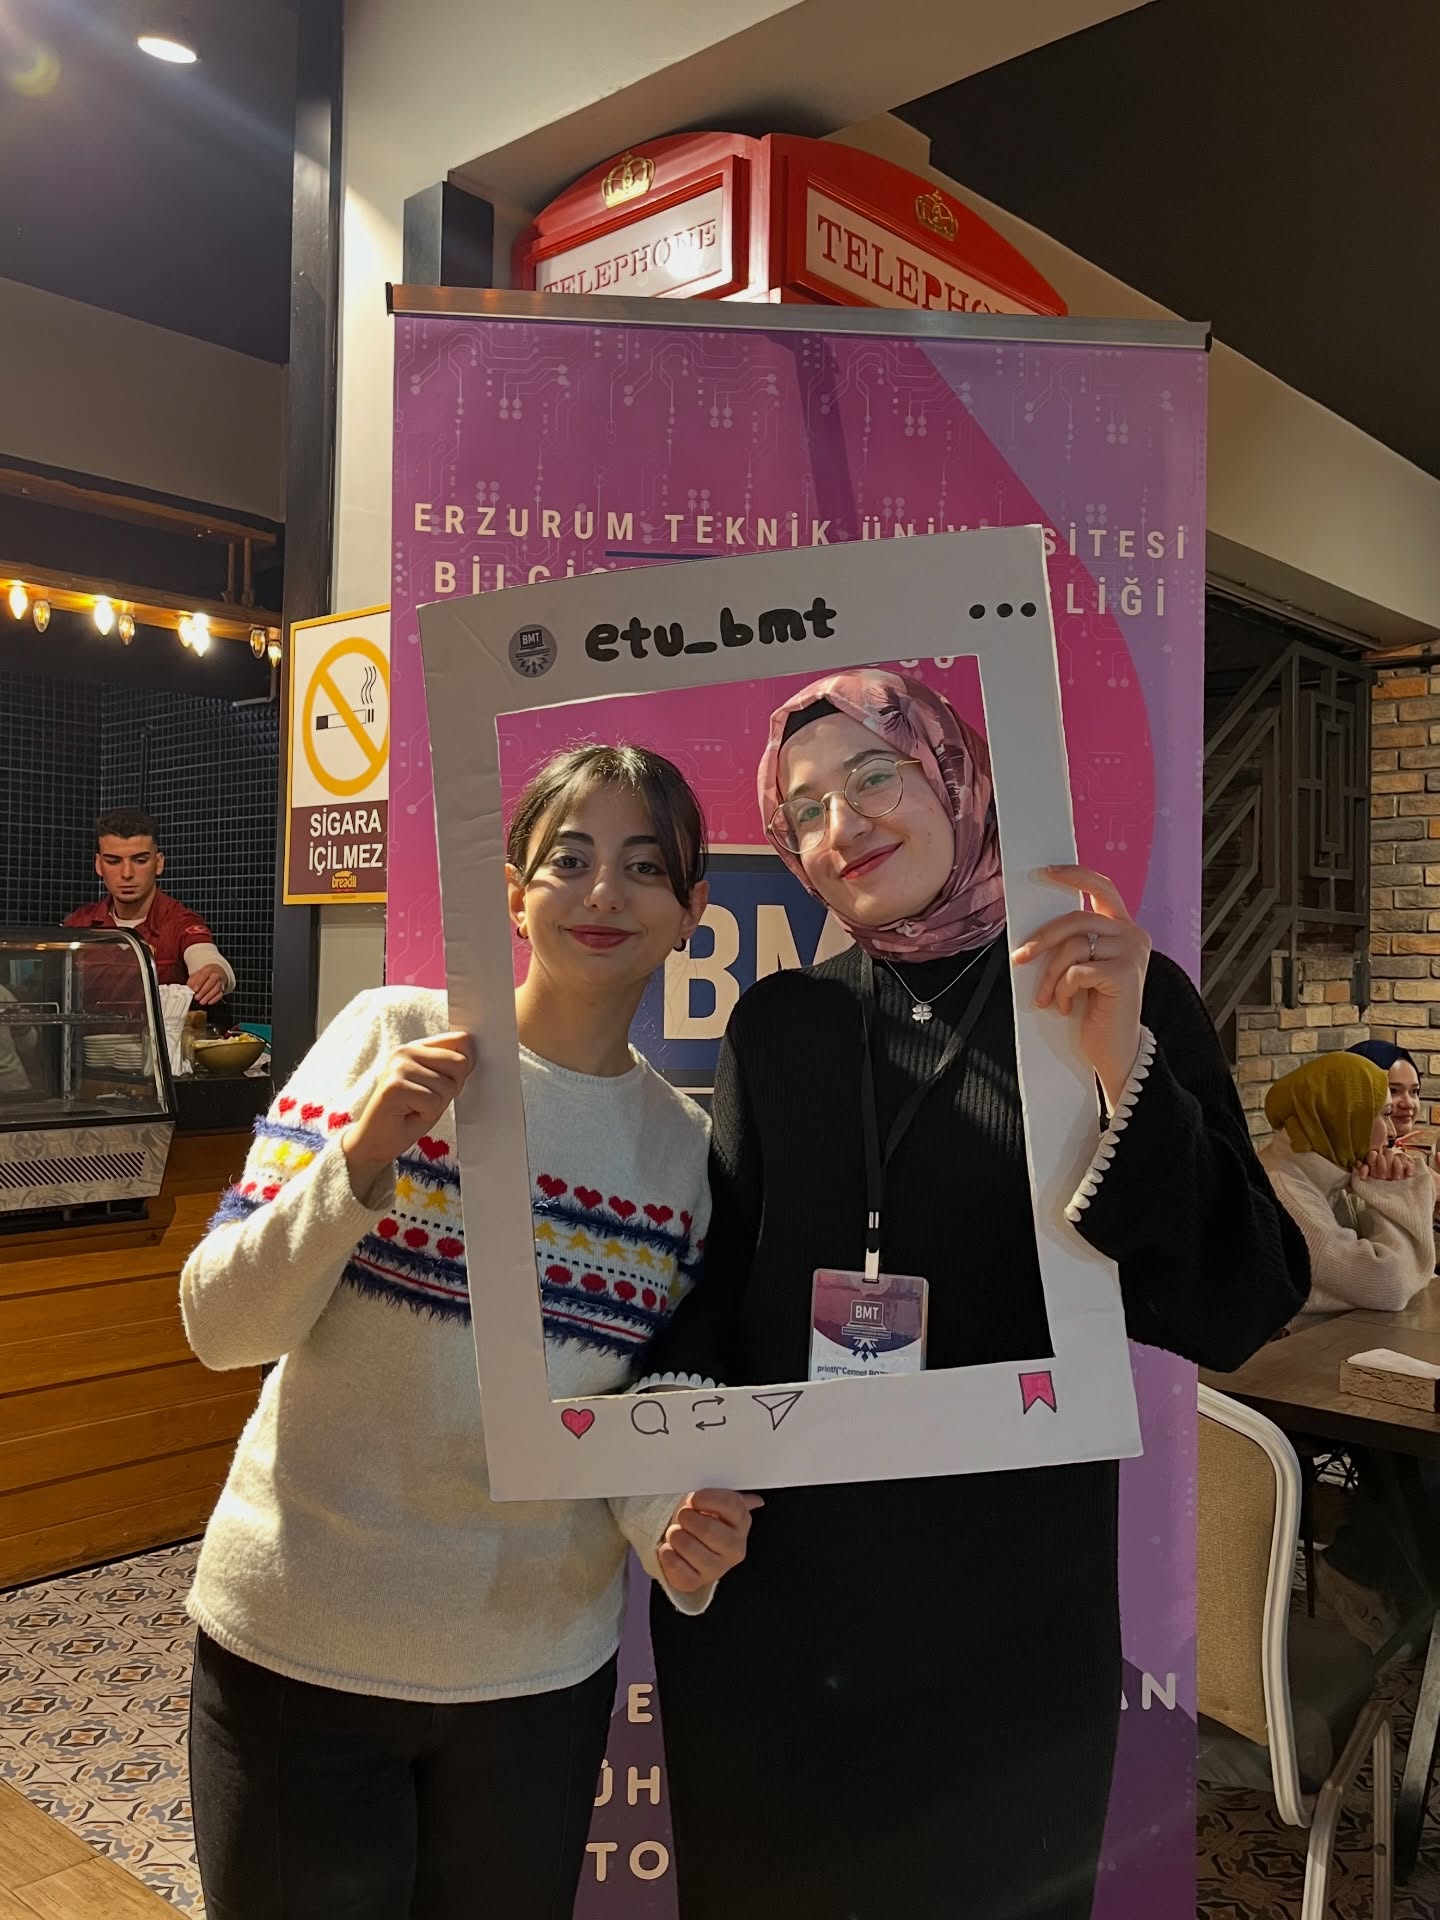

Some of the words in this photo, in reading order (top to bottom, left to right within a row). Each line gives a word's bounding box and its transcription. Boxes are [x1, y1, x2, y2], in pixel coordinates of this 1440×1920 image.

[818, 214, 1003, 313] TELEPH
[414, 503, 634, 541] ERZURUM
[665, 512, 833, 546] TEKNİK
[862, 515, 1185, 560] ÜNİSİTESİ
[1066, 576, 1165, 617] LİĞİ
[522, 632, 540, 645] BMT
[585, 597, 837, 662] etu_bmt
[310, 807, 382, 837] SİGARA
[309, 840, 384, 876] İÇİLMEZ
[664, 903, 857, 1040] BM
[855, 1305, 880, 1320] BMT
